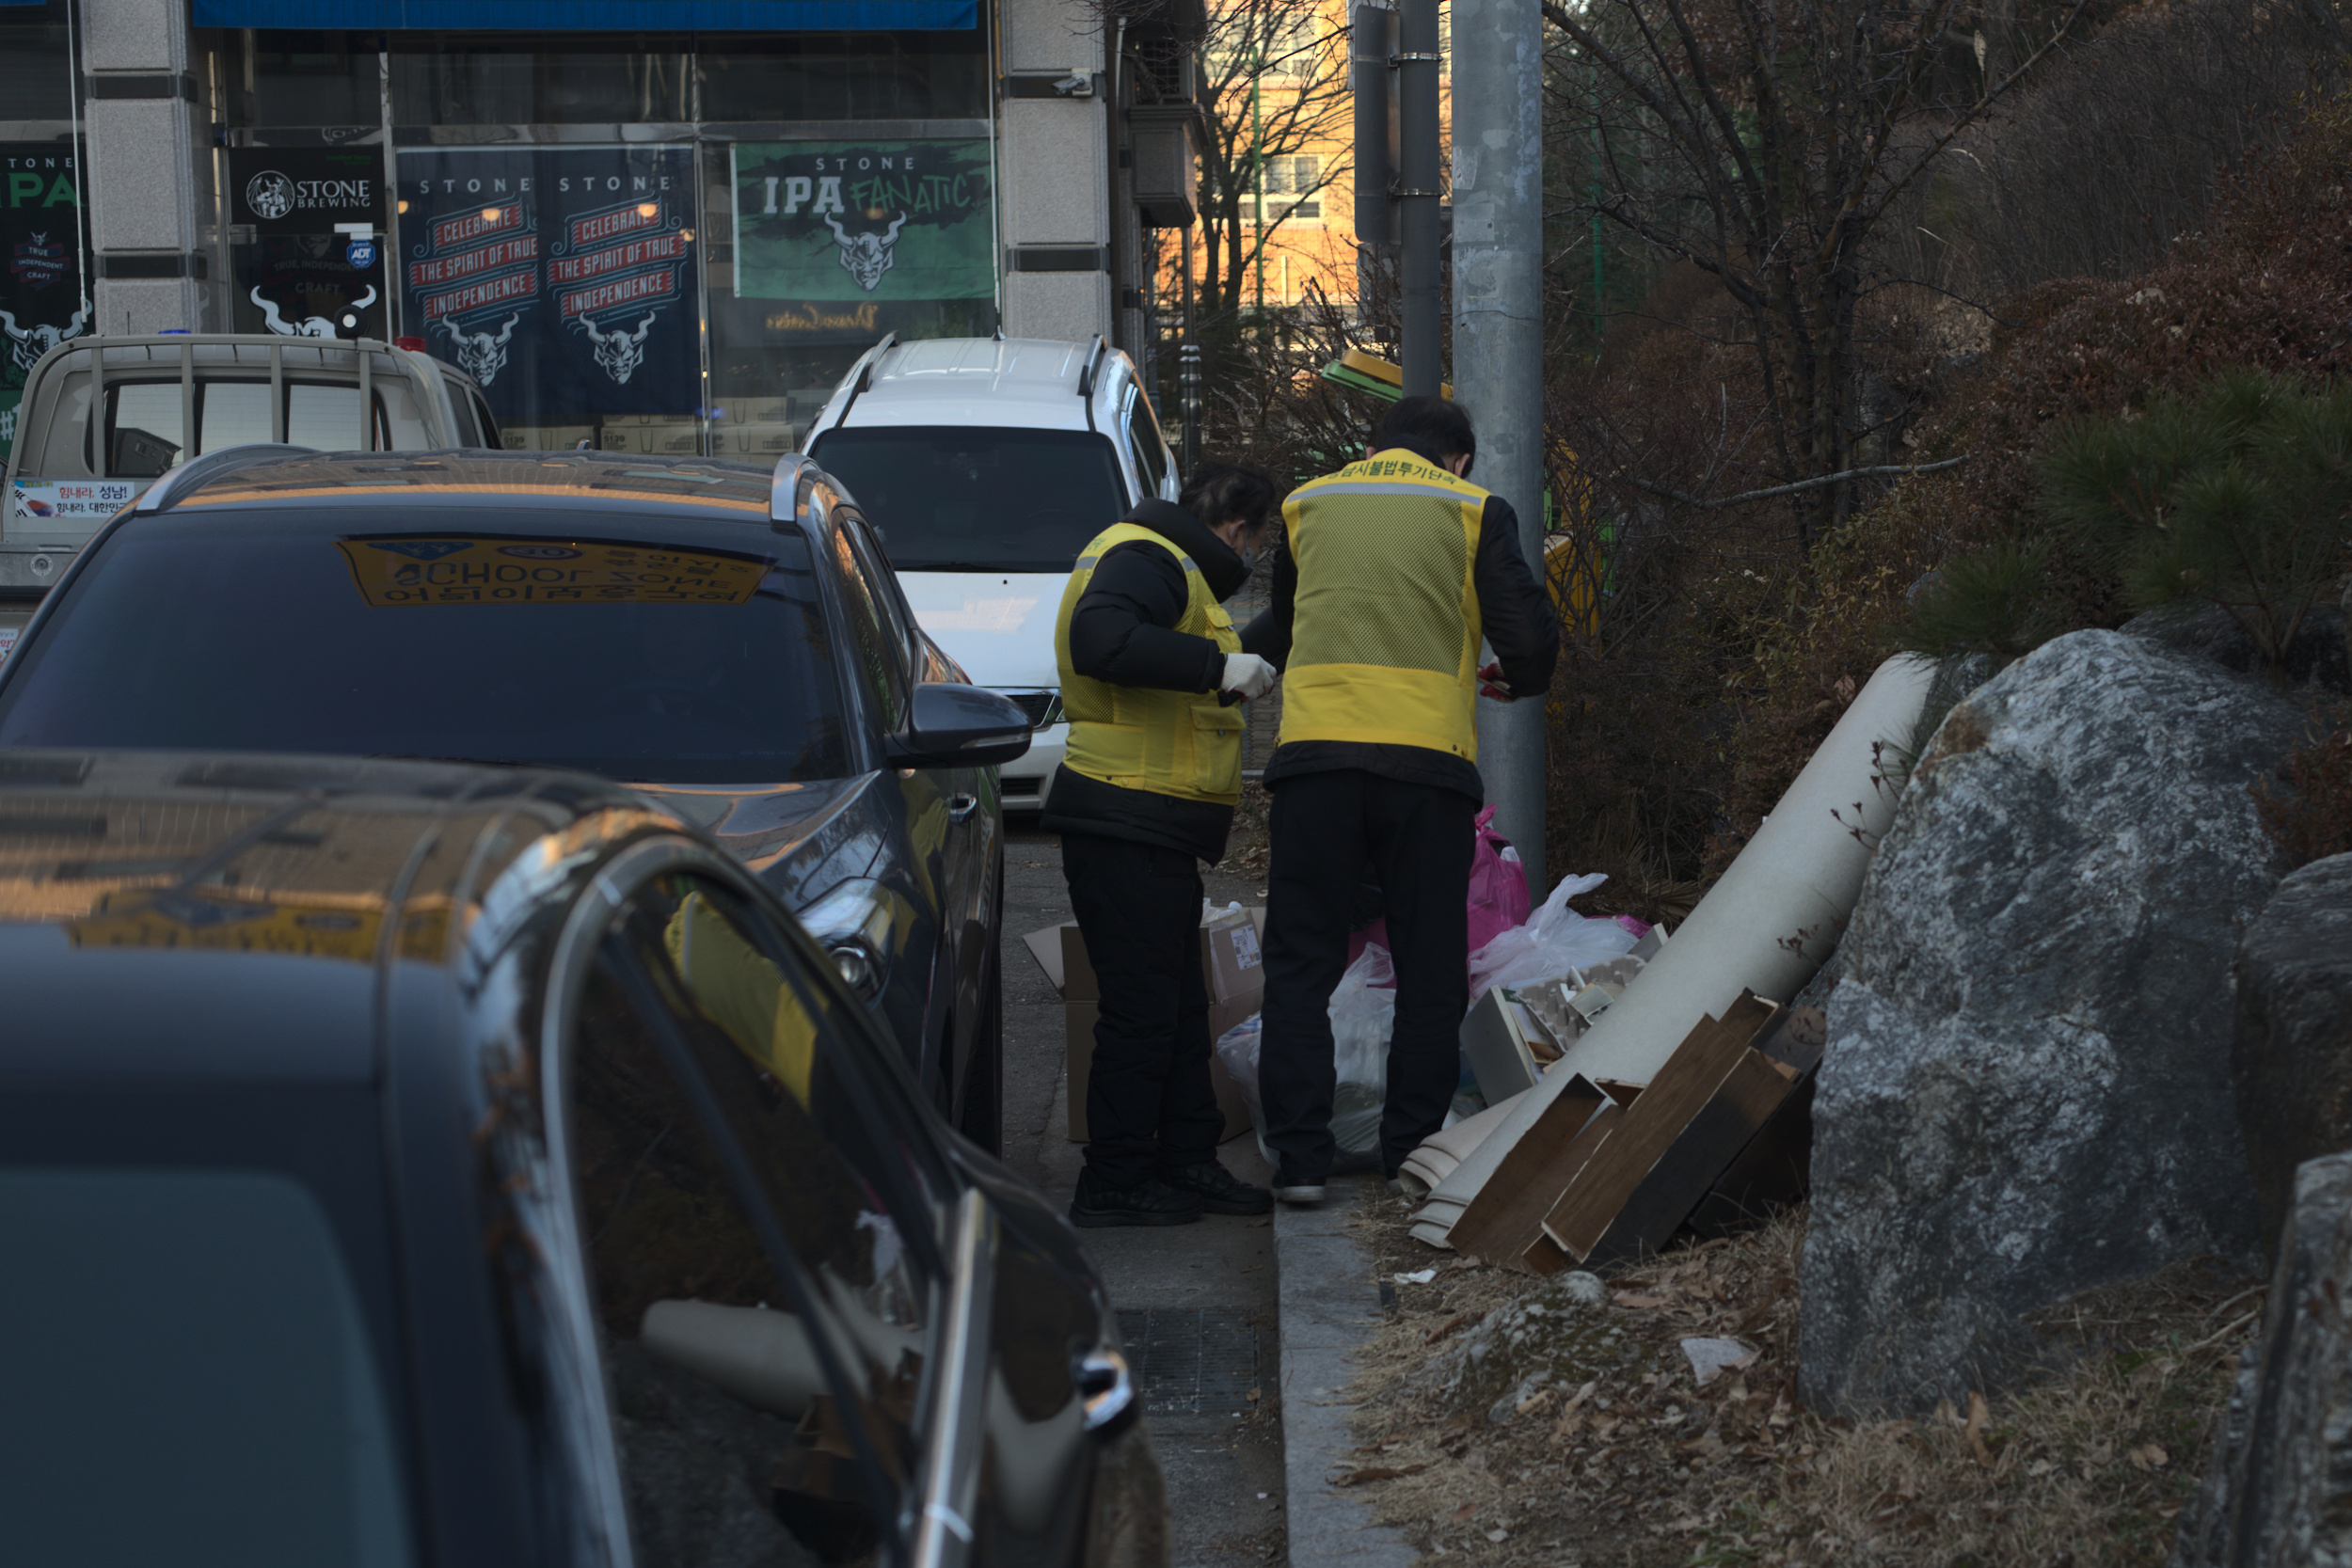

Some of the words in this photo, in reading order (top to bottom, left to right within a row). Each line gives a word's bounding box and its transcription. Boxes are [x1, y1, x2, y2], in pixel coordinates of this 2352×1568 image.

[815, 157, 914, 170] STONE
[0, 171, 87, 209] PA
[296, 180, 370, 198] STONE
[420, 178, 531, 194] STONE
[559, 176, 670, 192] STONE
[764, 176, 845, 214] IPA
[850, 173, 971, 214] FANATIC
[297, 198, 371, 208] BREWING
[28, 246, 49, 256] TRUE
[351, 248, 372, 260] ADT
[558, 260, 580, 279] THE
[583, 247, 625, 275] SPIRIT
[627, 243, 643, 263] OF
[645, 237, 675, 259] TRUE
[18, 258, 63, 270] INDEPENDENT
[421, 261, 443, 282] THE
[446, 249, 486, 277] SPIRIT
[489, 245, 505, 265] OF
[507, 237, 538, 261] TRUE
[26, 271, 52, 280] CRAFT
[294, 282, 341, 294] CRAFT
[433, 274, 527, 315] INDEPENDENCE
[570, 273, 663, 312] INDEPENDENCE
[59, 486, 95, 499] 힘내라,
[99, 485, 128, 499] 성남!
